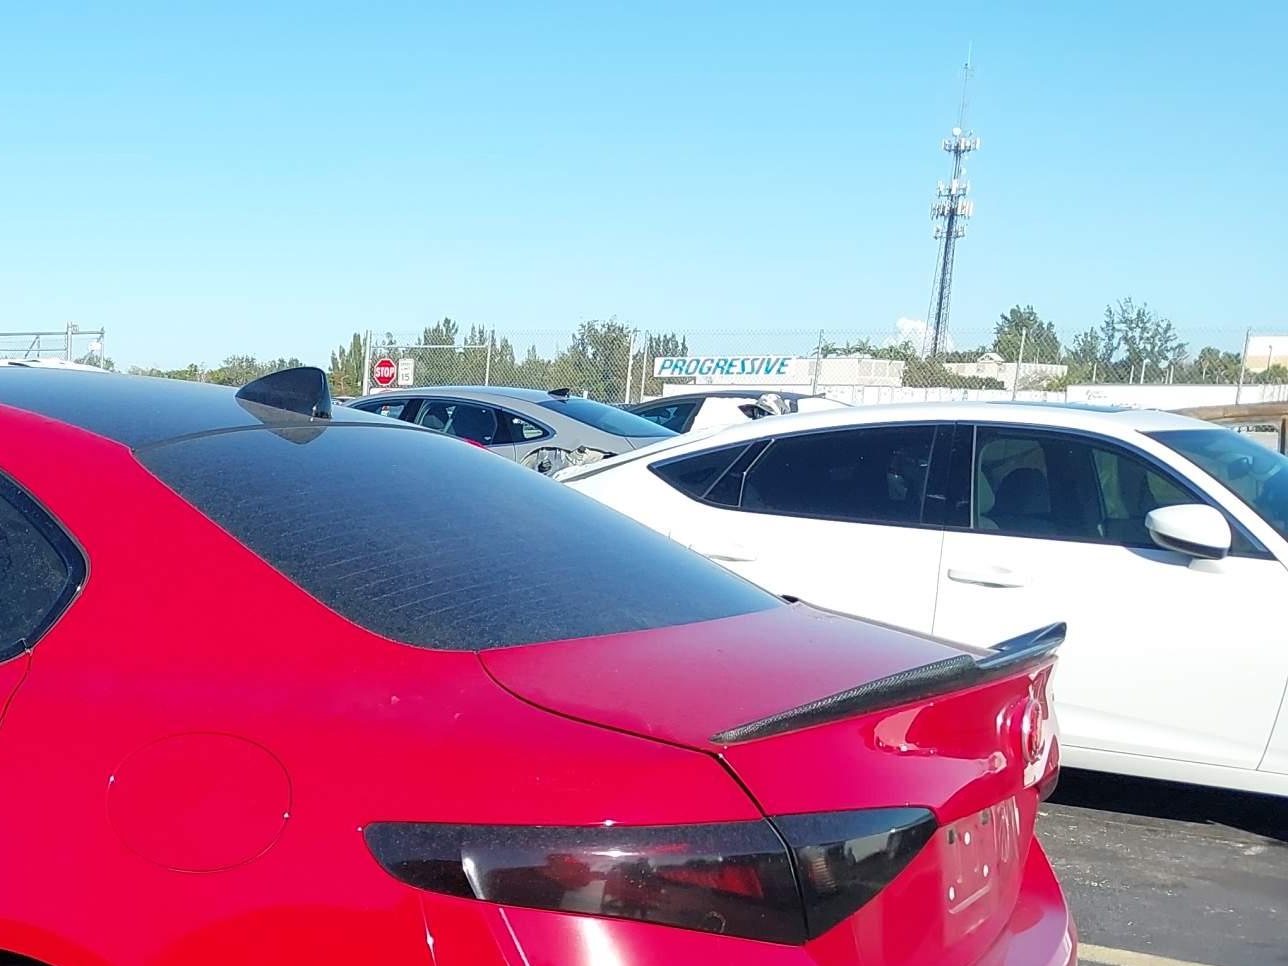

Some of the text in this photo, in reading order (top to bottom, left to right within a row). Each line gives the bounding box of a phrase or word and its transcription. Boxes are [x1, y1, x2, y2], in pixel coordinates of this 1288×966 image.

[658, 357, 791, 376] PROGRESSIVE
[376, 367, 395, 378] STOP
[401, 373, 410, 382] 15
